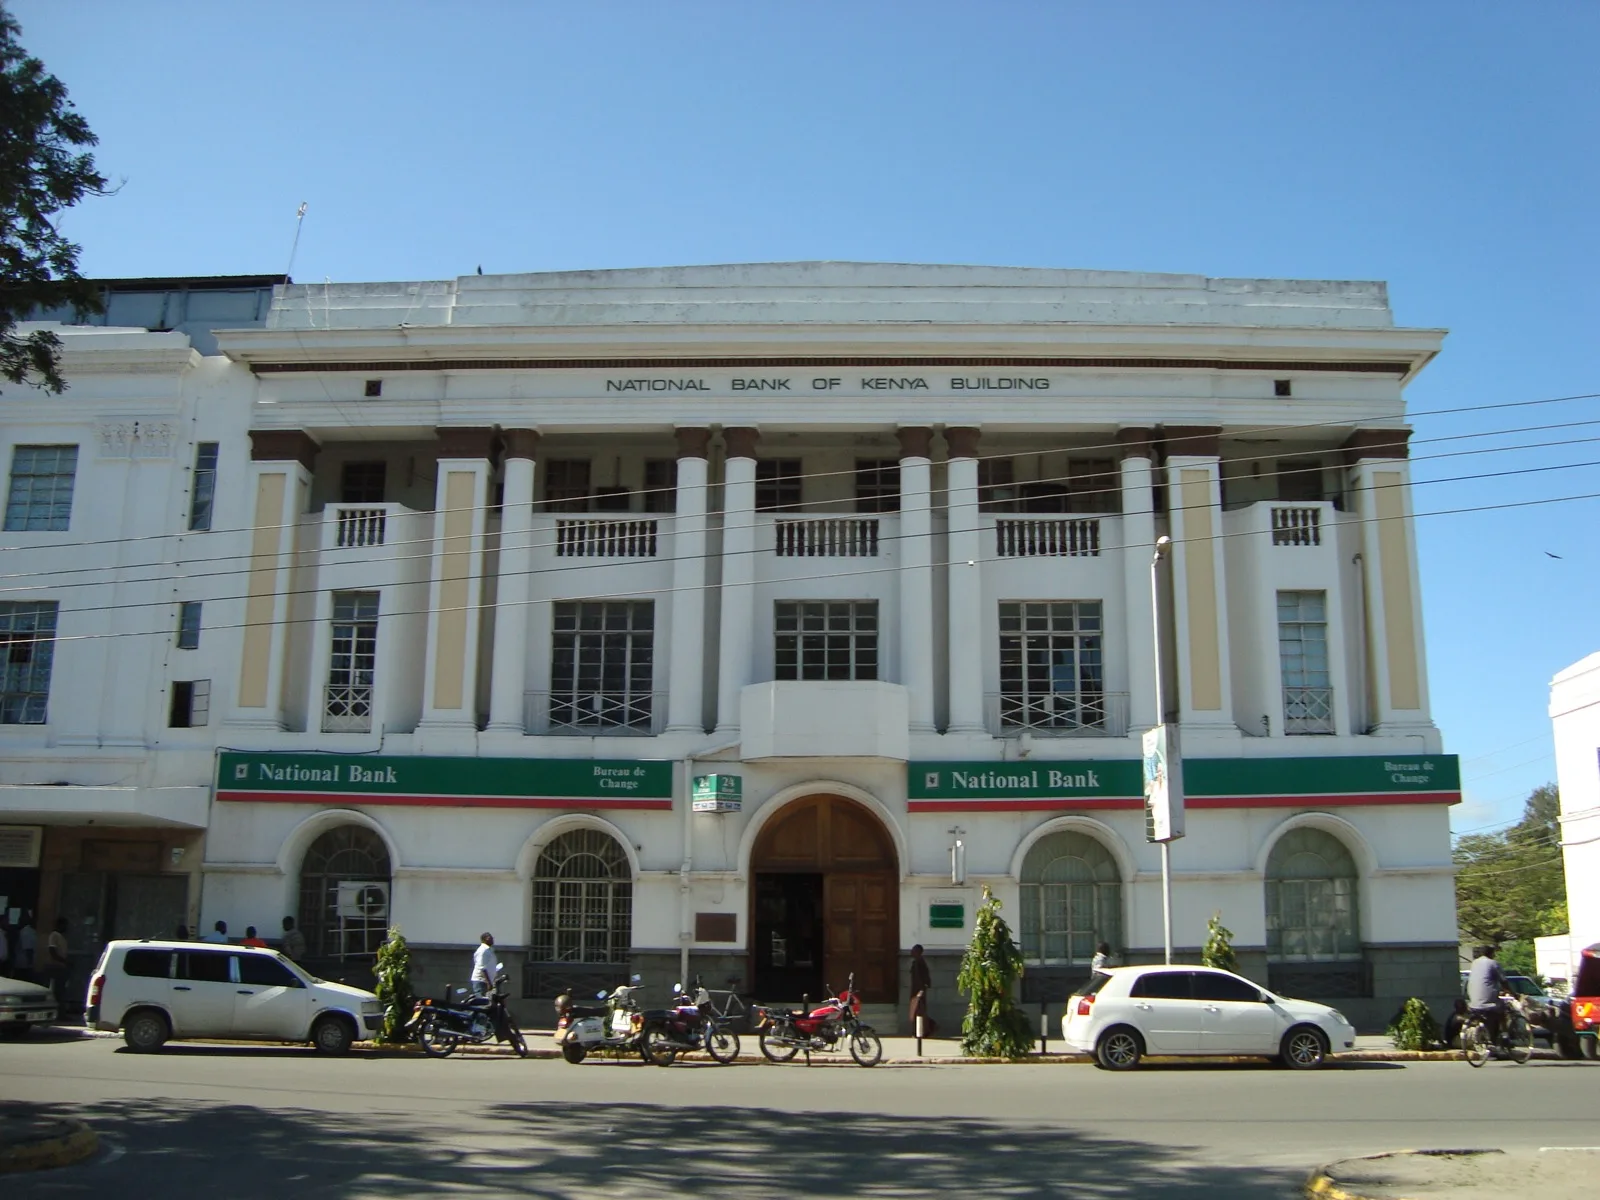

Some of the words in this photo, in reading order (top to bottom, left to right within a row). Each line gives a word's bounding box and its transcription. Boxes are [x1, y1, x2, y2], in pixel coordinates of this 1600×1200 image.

[606, 378, 710, 392] NATIONAL
[731, 378, 791, 391] BANK
[812, 378, 841, 390] OF
[861, 378, 929, 390] KENYA
[950, 378, 1050, 390] BUILDING
[593, 765, 630, 776] Bureau
[633, 766, 646, 776] de
[1383, 761, 1420, 771] Bureau
[1422, 761, 1434, 771] de
[259, 763, 340, 782] National
[349, 765, 397, 783] Bank
[1391, 773, 1429, 784] Change
[599, 778, 639, 790] Change
[721, 776, 735, 787] 24
[951, 771, 1039, 789] National
[1048, 770, 1100, 788] Bank
